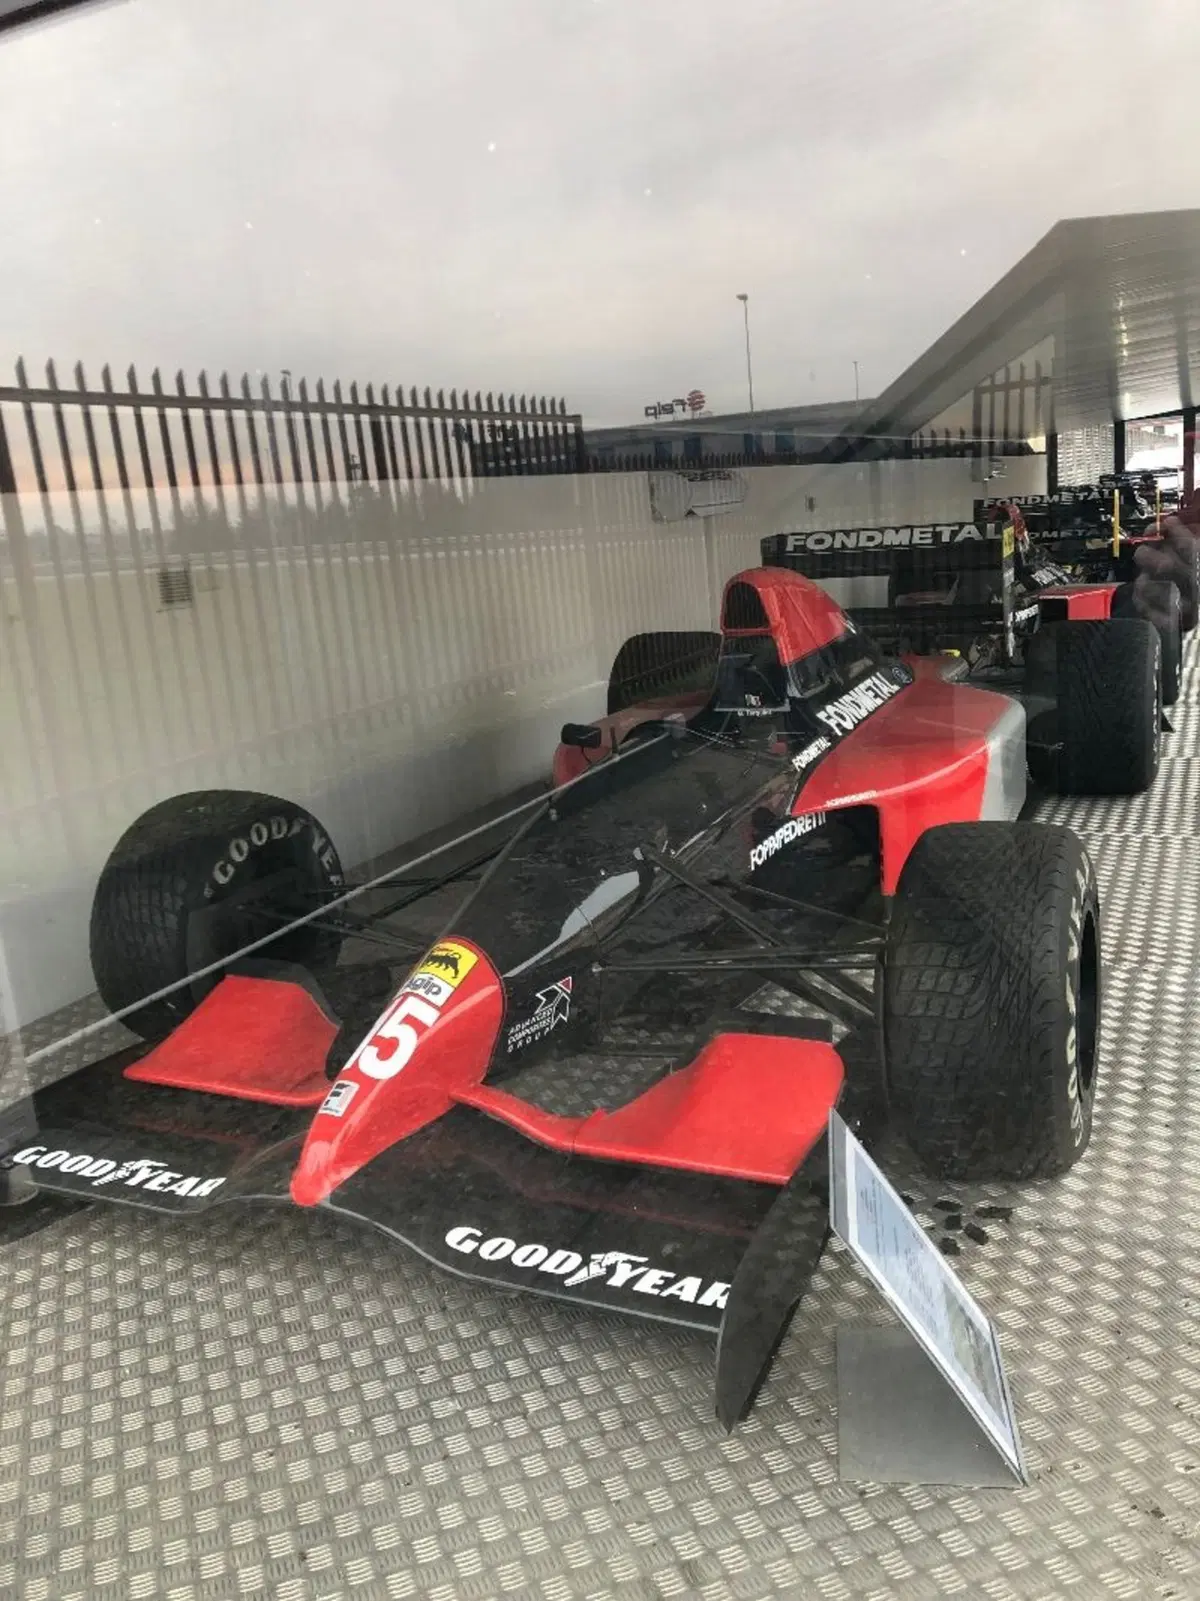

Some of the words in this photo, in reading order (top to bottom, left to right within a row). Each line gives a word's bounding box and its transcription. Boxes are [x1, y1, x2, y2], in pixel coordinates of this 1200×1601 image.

[785, 523, 1000, 552] FONDMETAL
[815, 671, 901, 736] FONDMETAL
[791, 736, 832, 772] FONDMETAL
[12, 1145, 228, 1198] GOODYEAR
